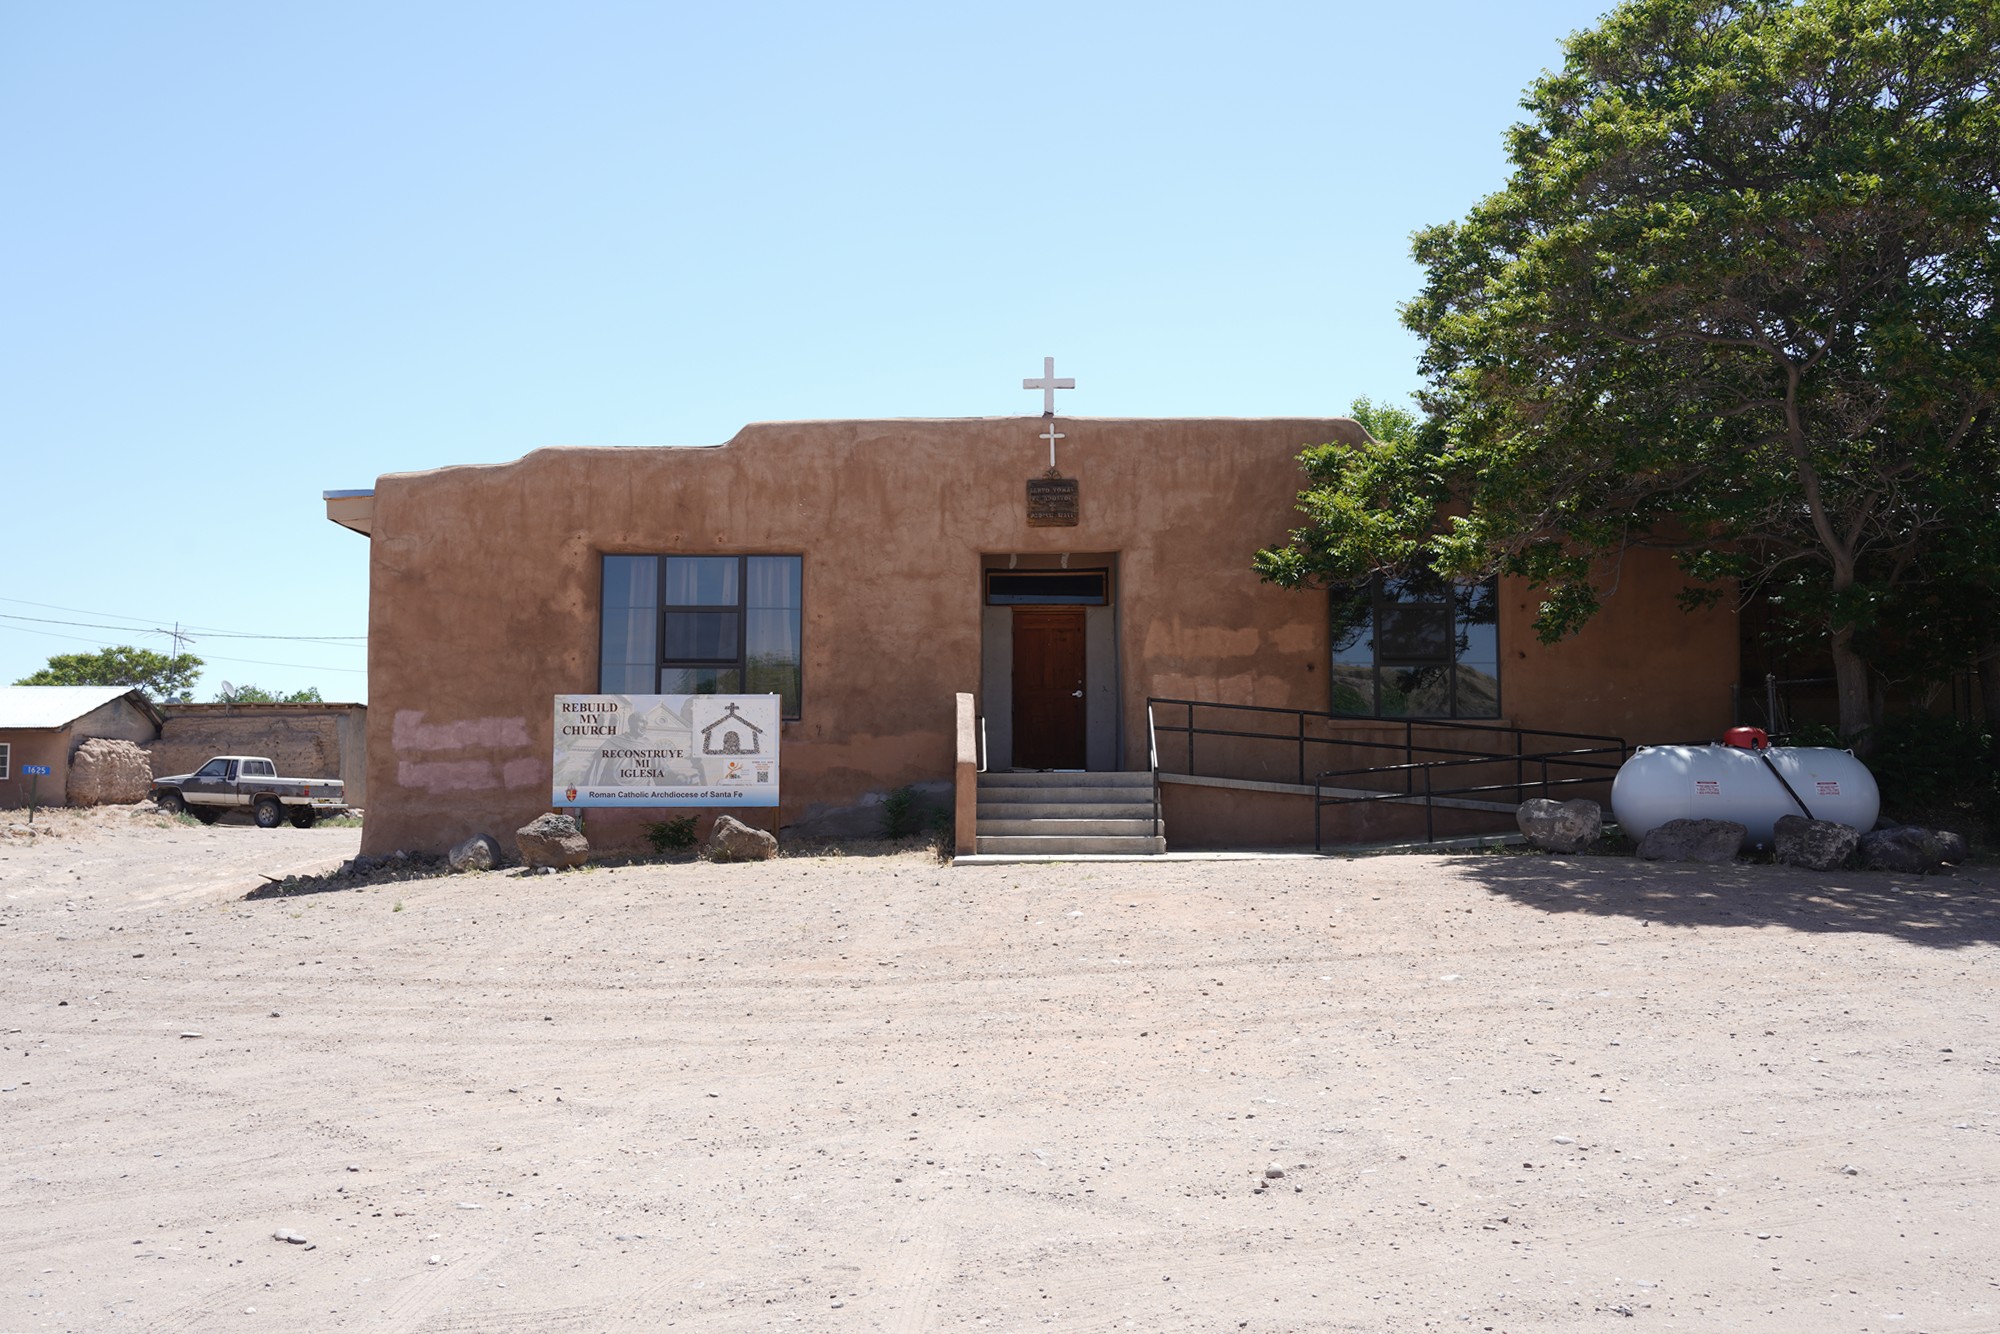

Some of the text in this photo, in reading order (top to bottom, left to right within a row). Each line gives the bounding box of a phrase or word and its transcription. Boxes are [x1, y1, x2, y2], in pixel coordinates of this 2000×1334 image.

[562, 703, 618, 713] REBUILD
[580, 714, 600, 724] MY
[562, 725, 617, 736] CHURCH
[602, 749, 684, 759] RECONSTRUYE
[635, 759, 650, 768] MI
[27, 766, 46, 775] 1625
[620, 768, 665, 778] IGLESIA
[589, 790, 743, 799] Roman Catholic Archdiocese of Santa Fe
